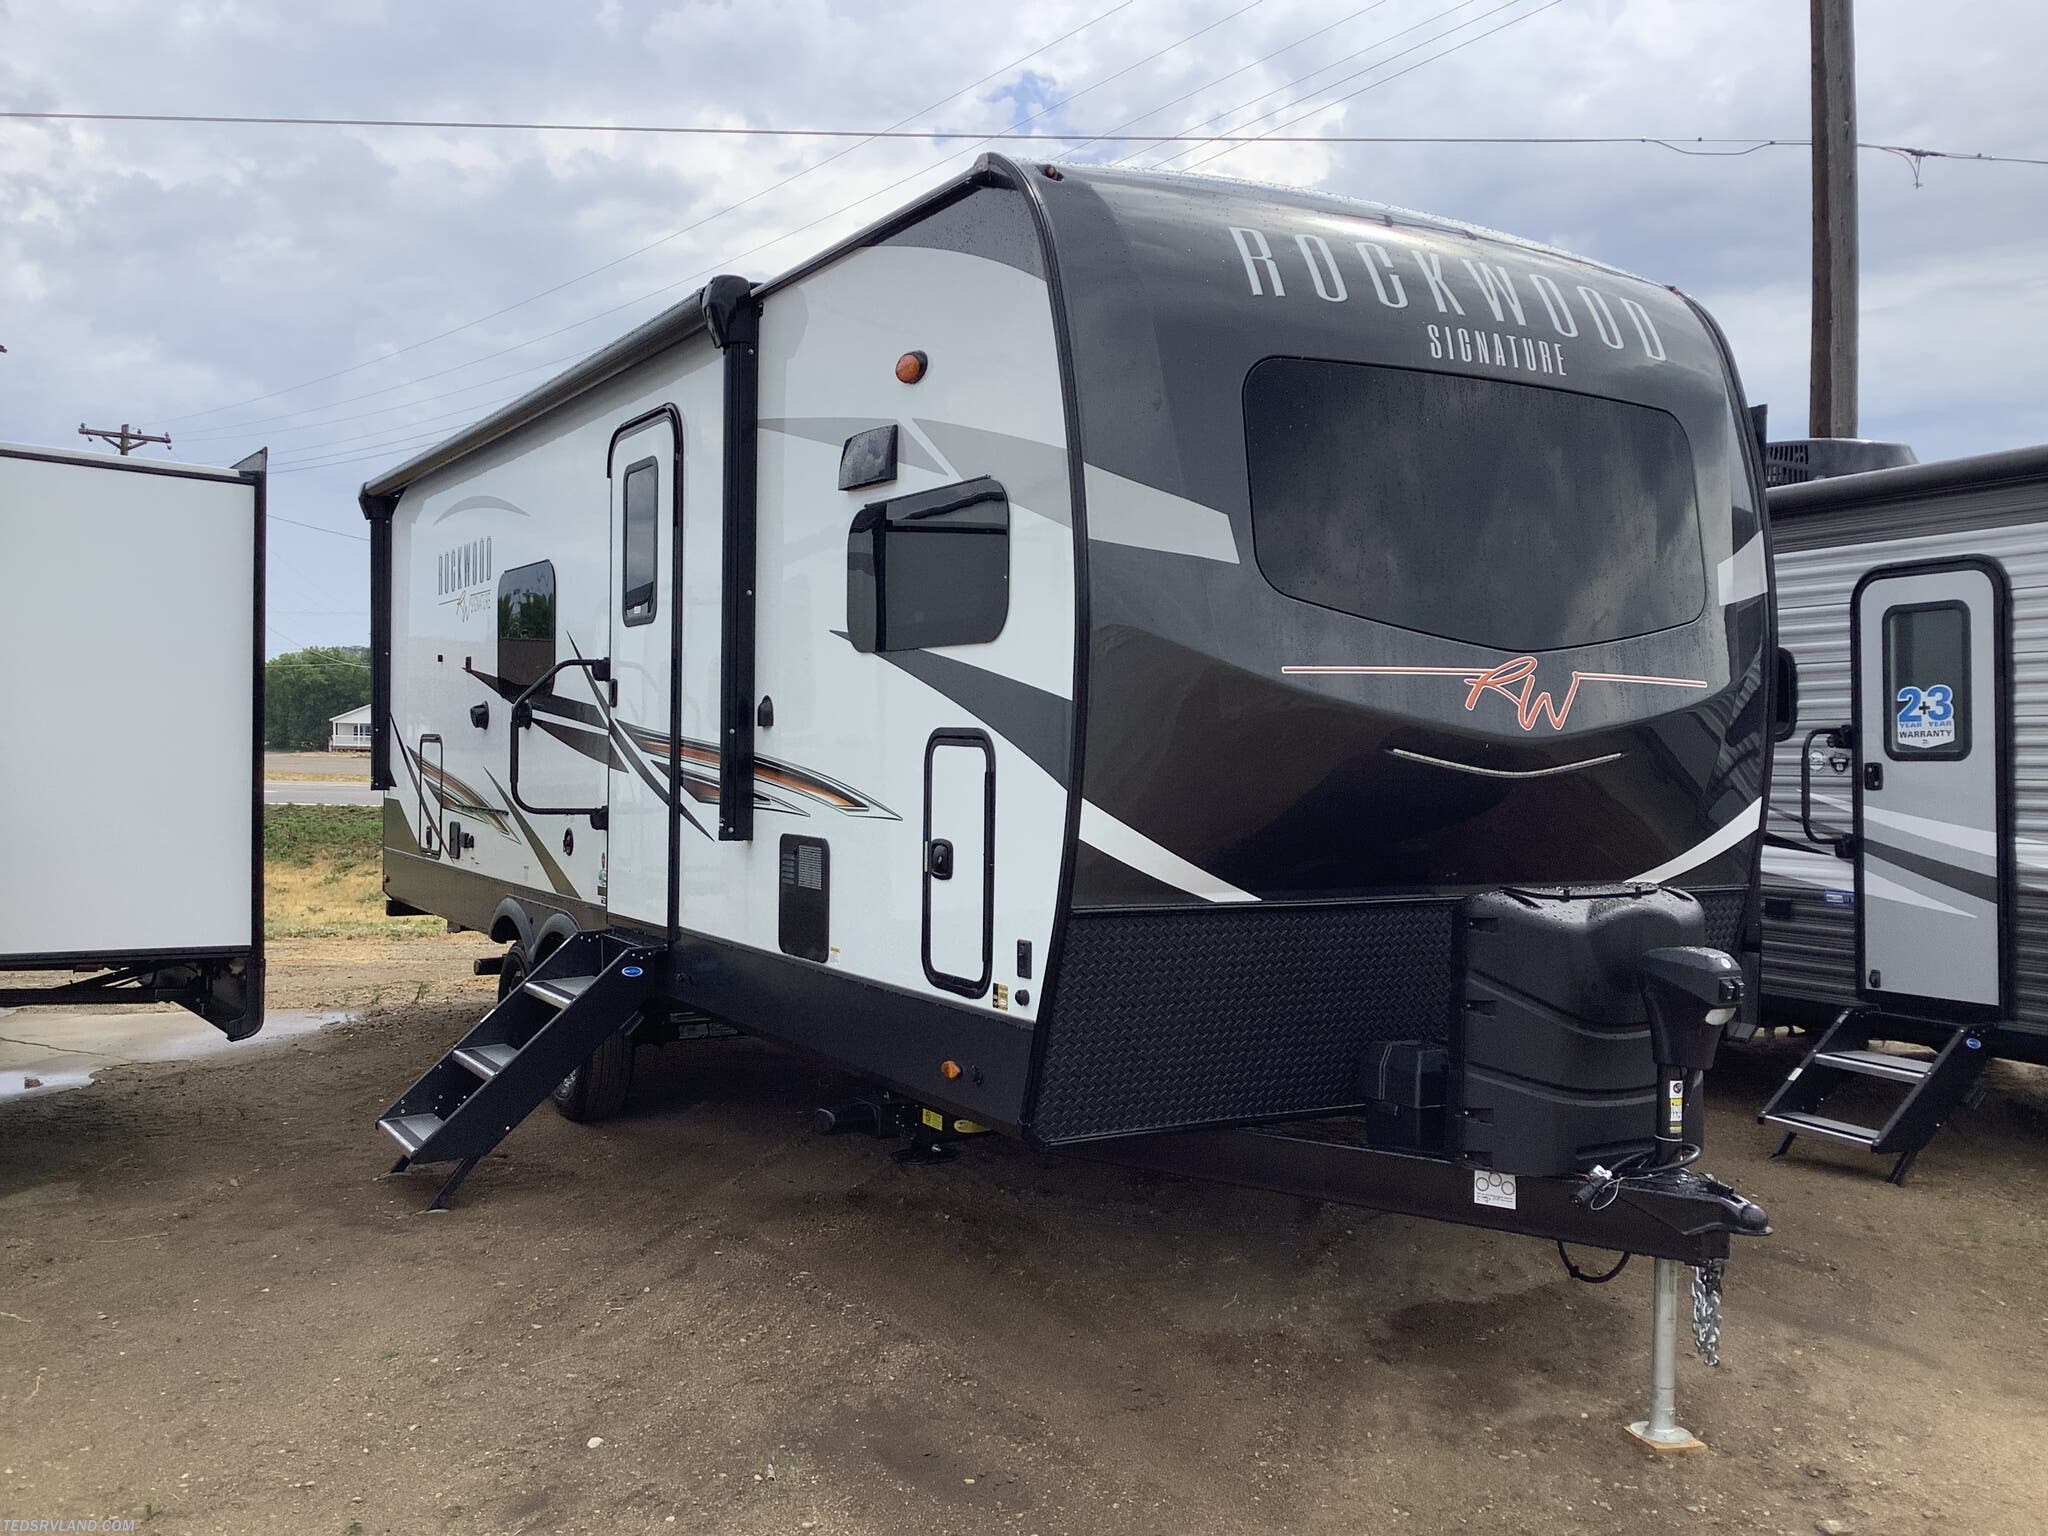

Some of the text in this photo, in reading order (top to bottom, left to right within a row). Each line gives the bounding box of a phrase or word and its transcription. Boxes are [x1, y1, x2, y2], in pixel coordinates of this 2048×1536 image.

[1228, 226, 1667, 362] ROCKWOOD
[1426, 323, 1567, 376] SIGNATURE
[438, 535, 492, 596] ROCKWOOD
[1463, 655, 1581, 730] RW
[1899, 729, 1952, 738] WARRANTY
